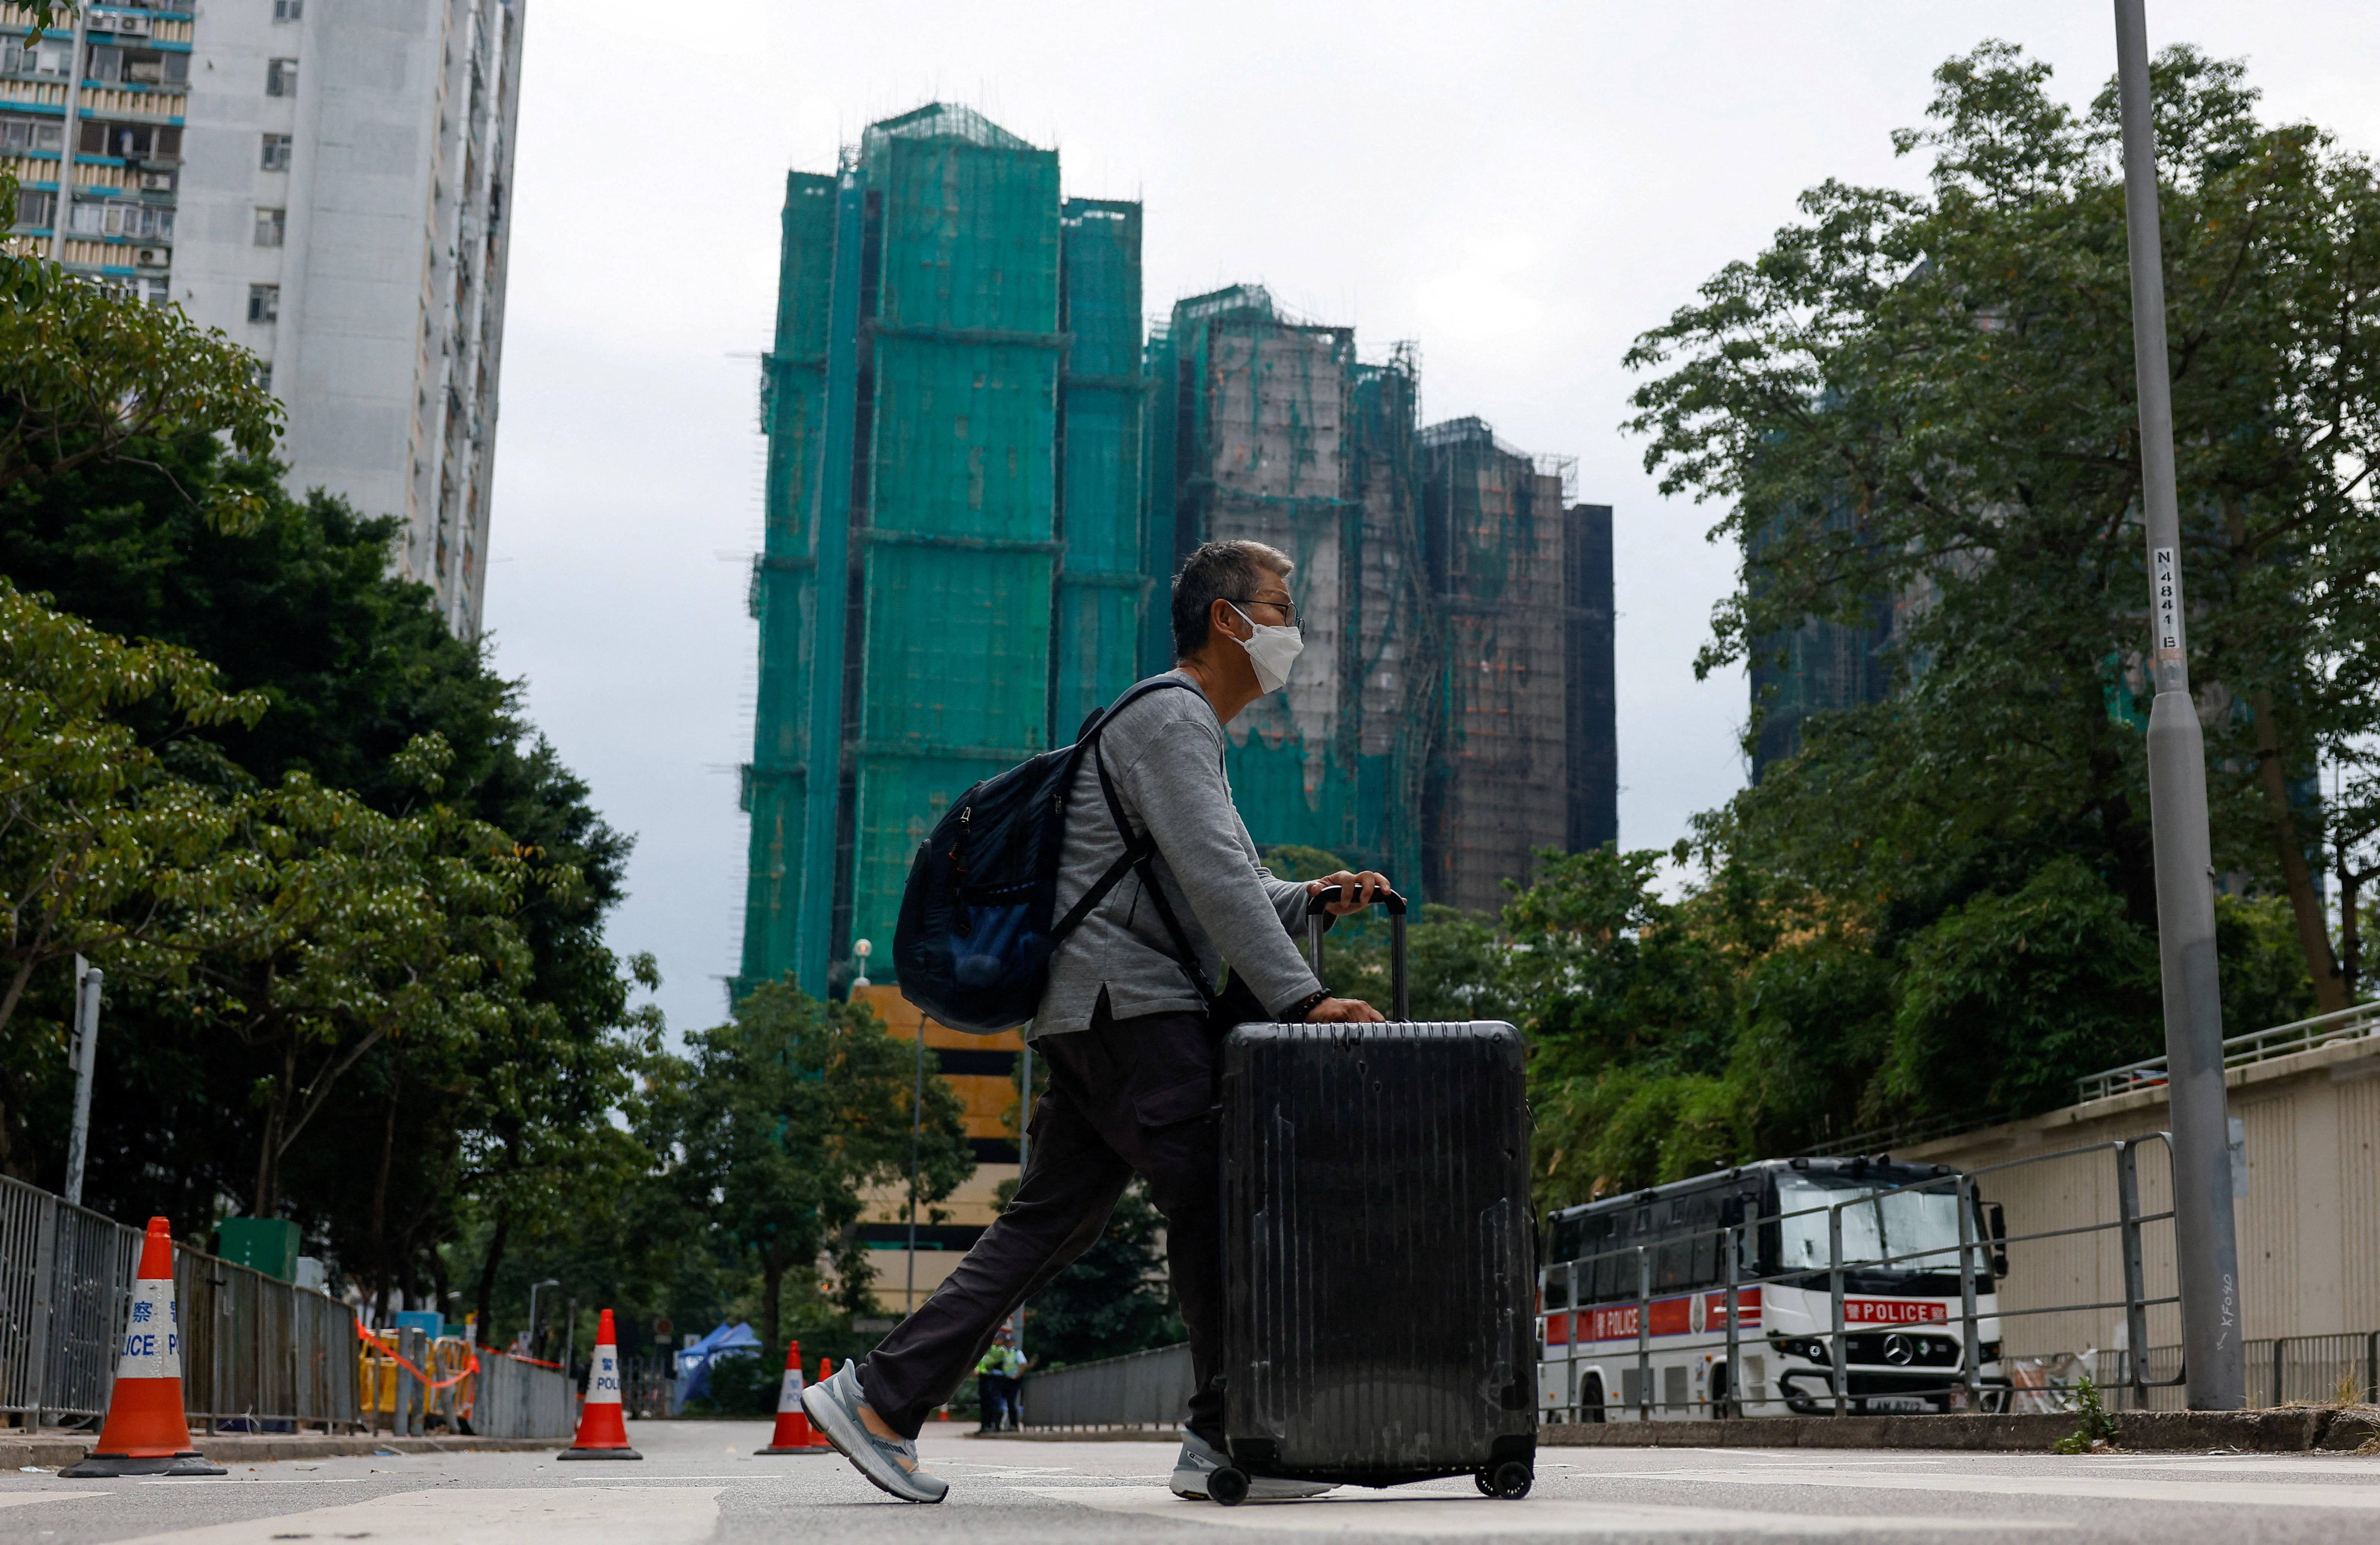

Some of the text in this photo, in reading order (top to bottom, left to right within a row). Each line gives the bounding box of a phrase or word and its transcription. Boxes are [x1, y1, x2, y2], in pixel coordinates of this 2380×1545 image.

[133, 1301, 153, 1323] 察
[1607, 1308, 1638, 1336] POLICE
[1863, 1303, 1928, 1321] POLICE
